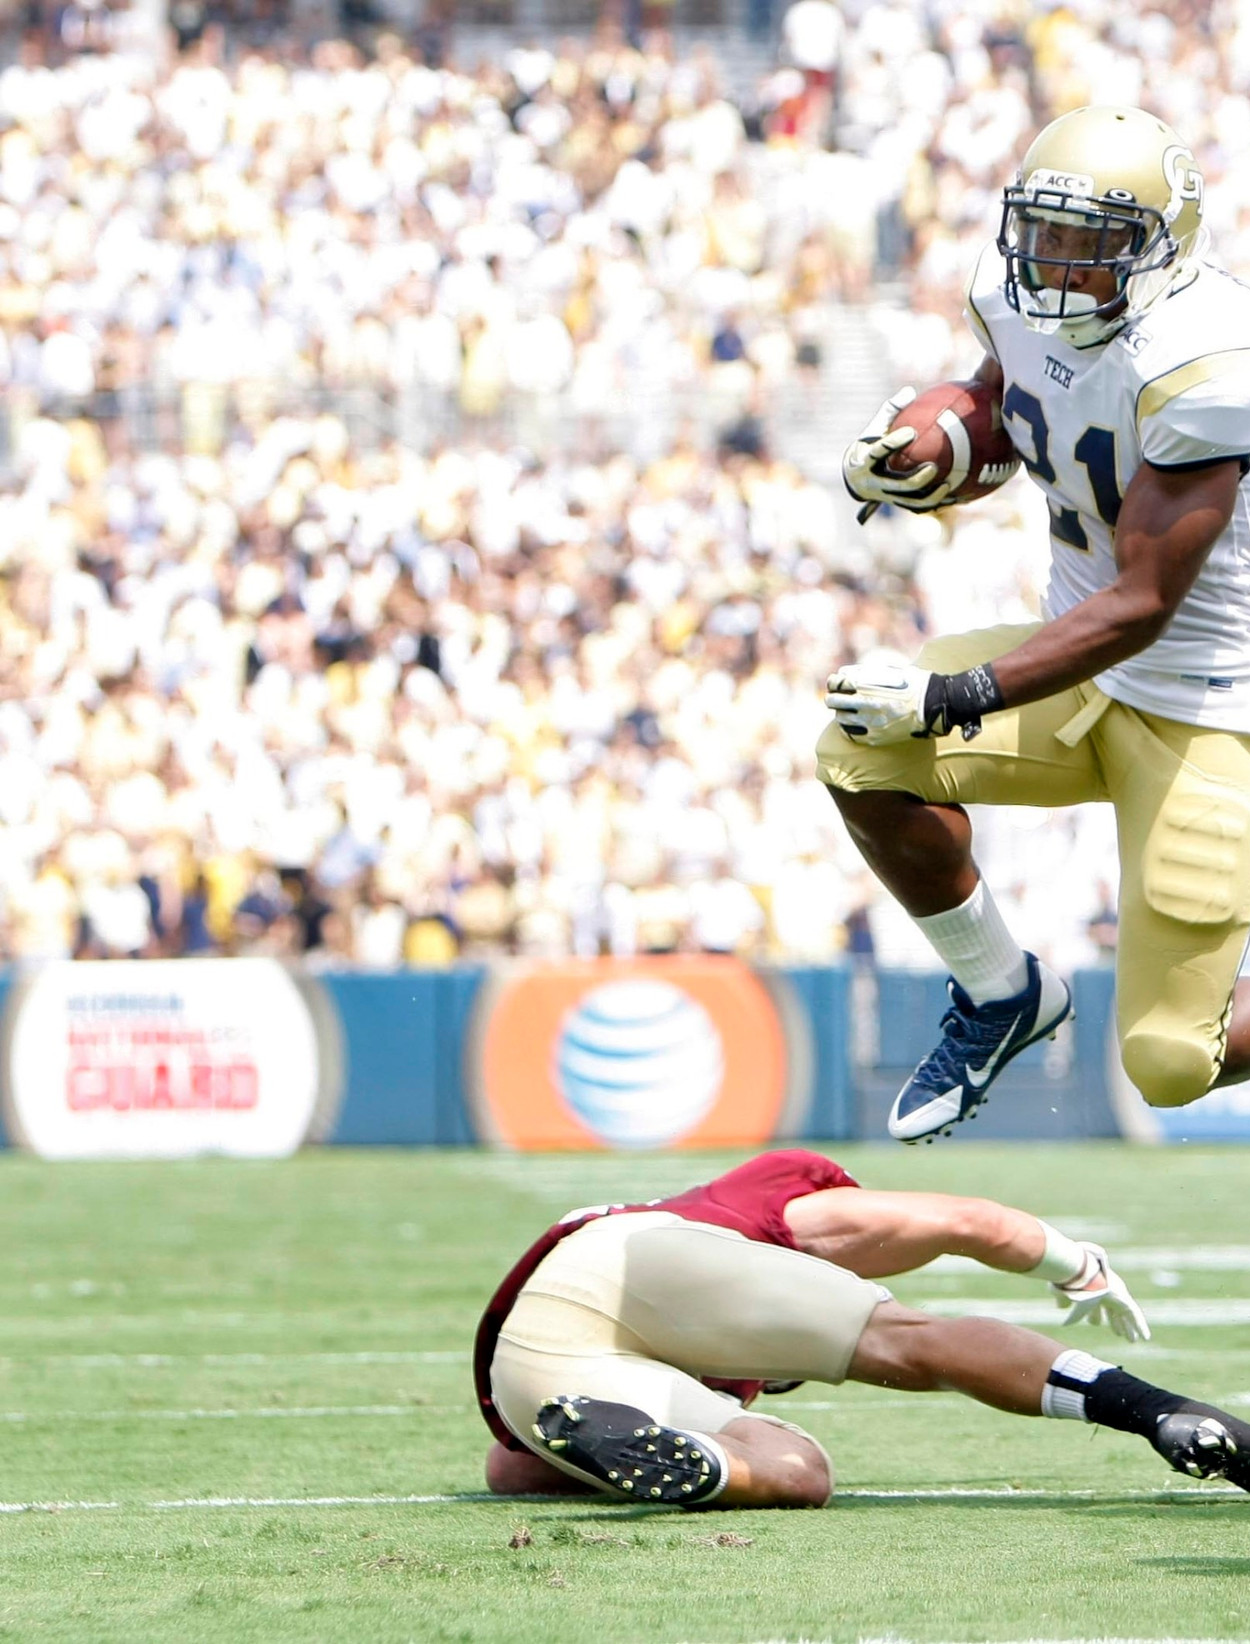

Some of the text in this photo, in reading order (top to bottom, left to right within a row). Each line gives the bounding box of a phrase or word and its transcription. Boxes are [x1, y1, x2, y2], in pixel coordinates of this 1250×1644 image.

[1045, 176, 1073, 188] ACC
[1045, 356, 1075, 390] TECH
[1002, 380, 1124, 553] 21
